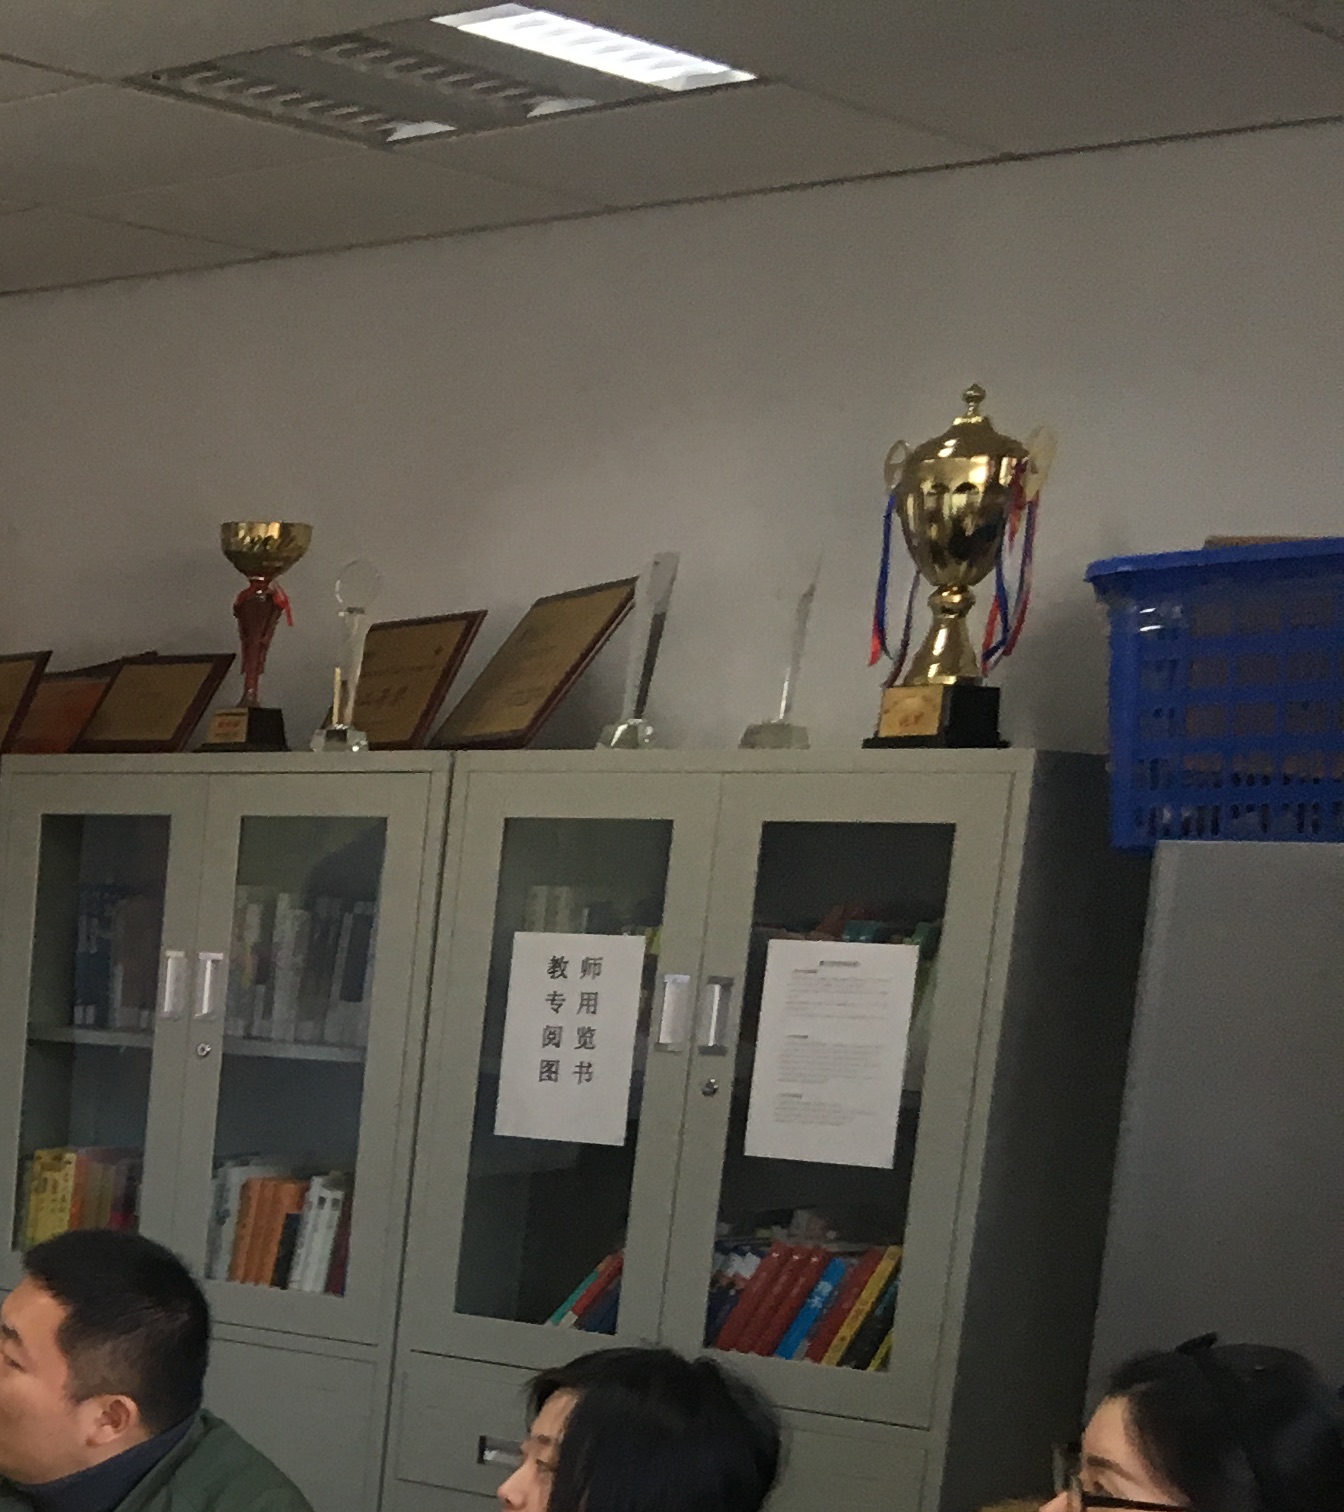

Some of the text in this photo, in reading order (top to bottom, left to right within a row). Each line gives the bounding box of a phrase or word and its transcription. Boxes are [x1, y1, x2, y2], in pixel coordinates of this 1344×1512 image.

[546, 955, 603, 980] 教师
[545, 990, 599, 1015] 专用
[541, 1024, 597, 1050] 阅览
[538, 1058, 594, 1085] 图书
